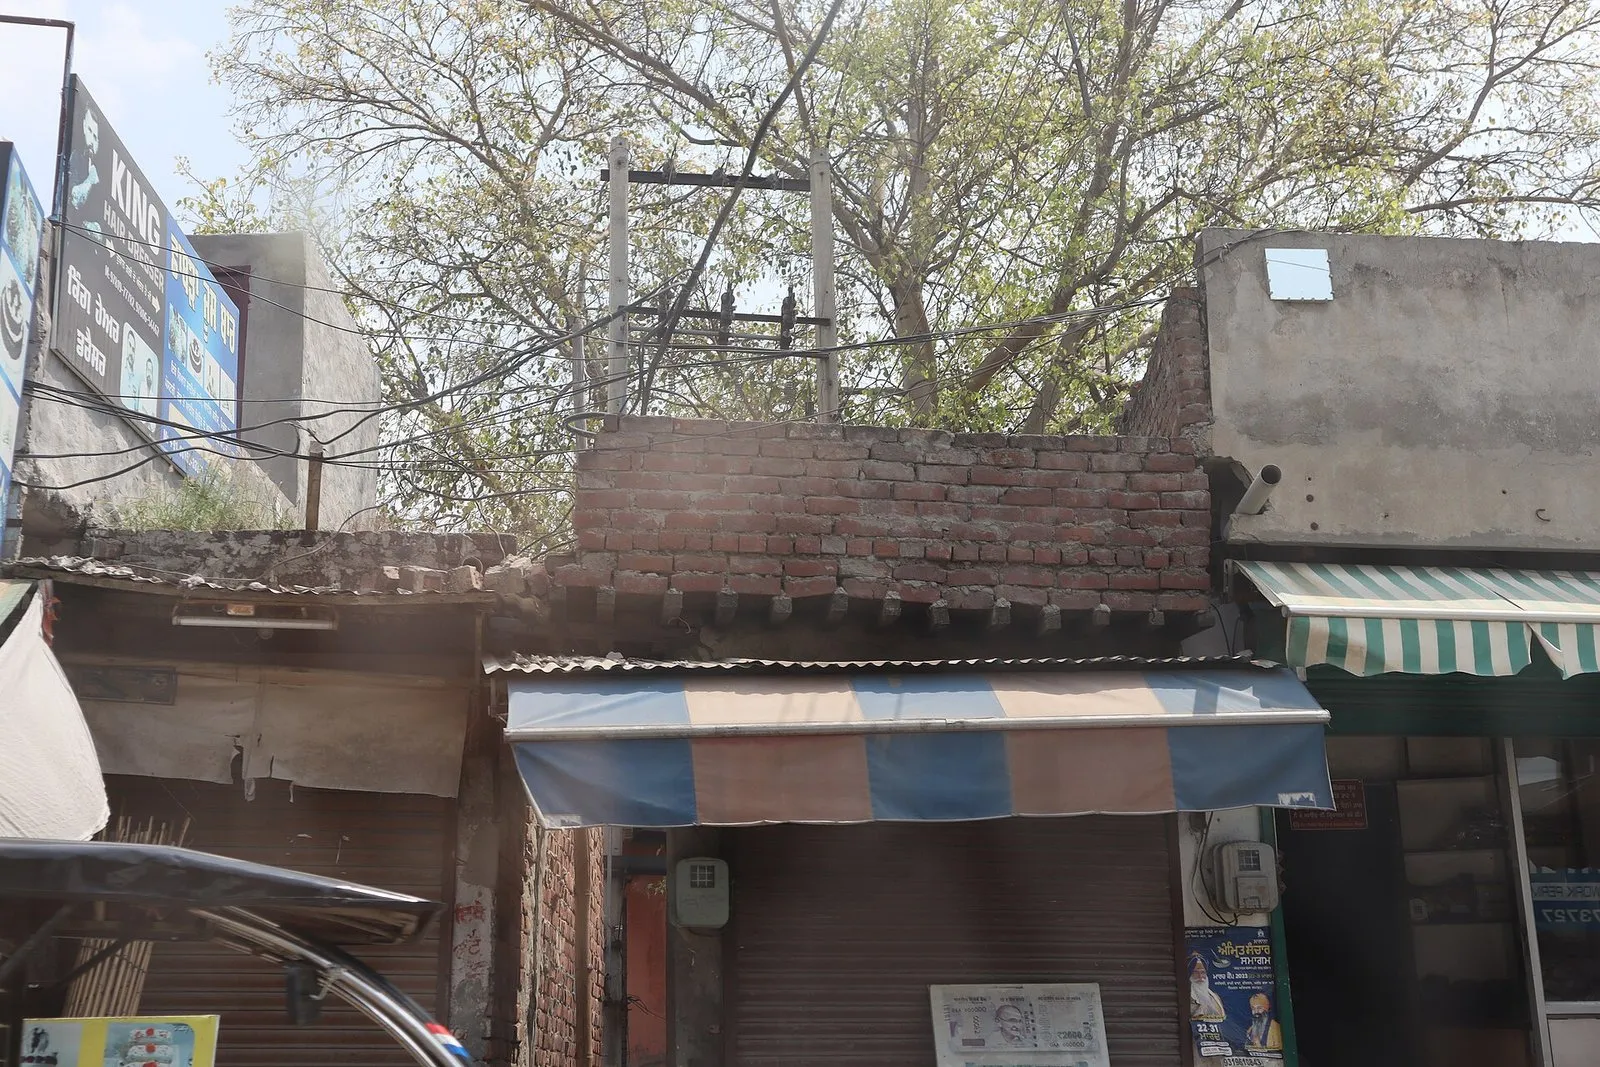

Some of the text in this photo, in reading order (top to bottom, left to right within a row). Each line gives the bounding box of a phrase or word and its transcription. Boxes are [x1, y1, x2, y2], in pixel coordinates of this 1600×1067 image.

[104, 200, 126, 243] HAIR
[127, 231, 164, 294] DRESSER
[111, 149, 160, 256] KING
[67, 264, 119, 344] ਕਿੰਗ ਹੇਅਰ
